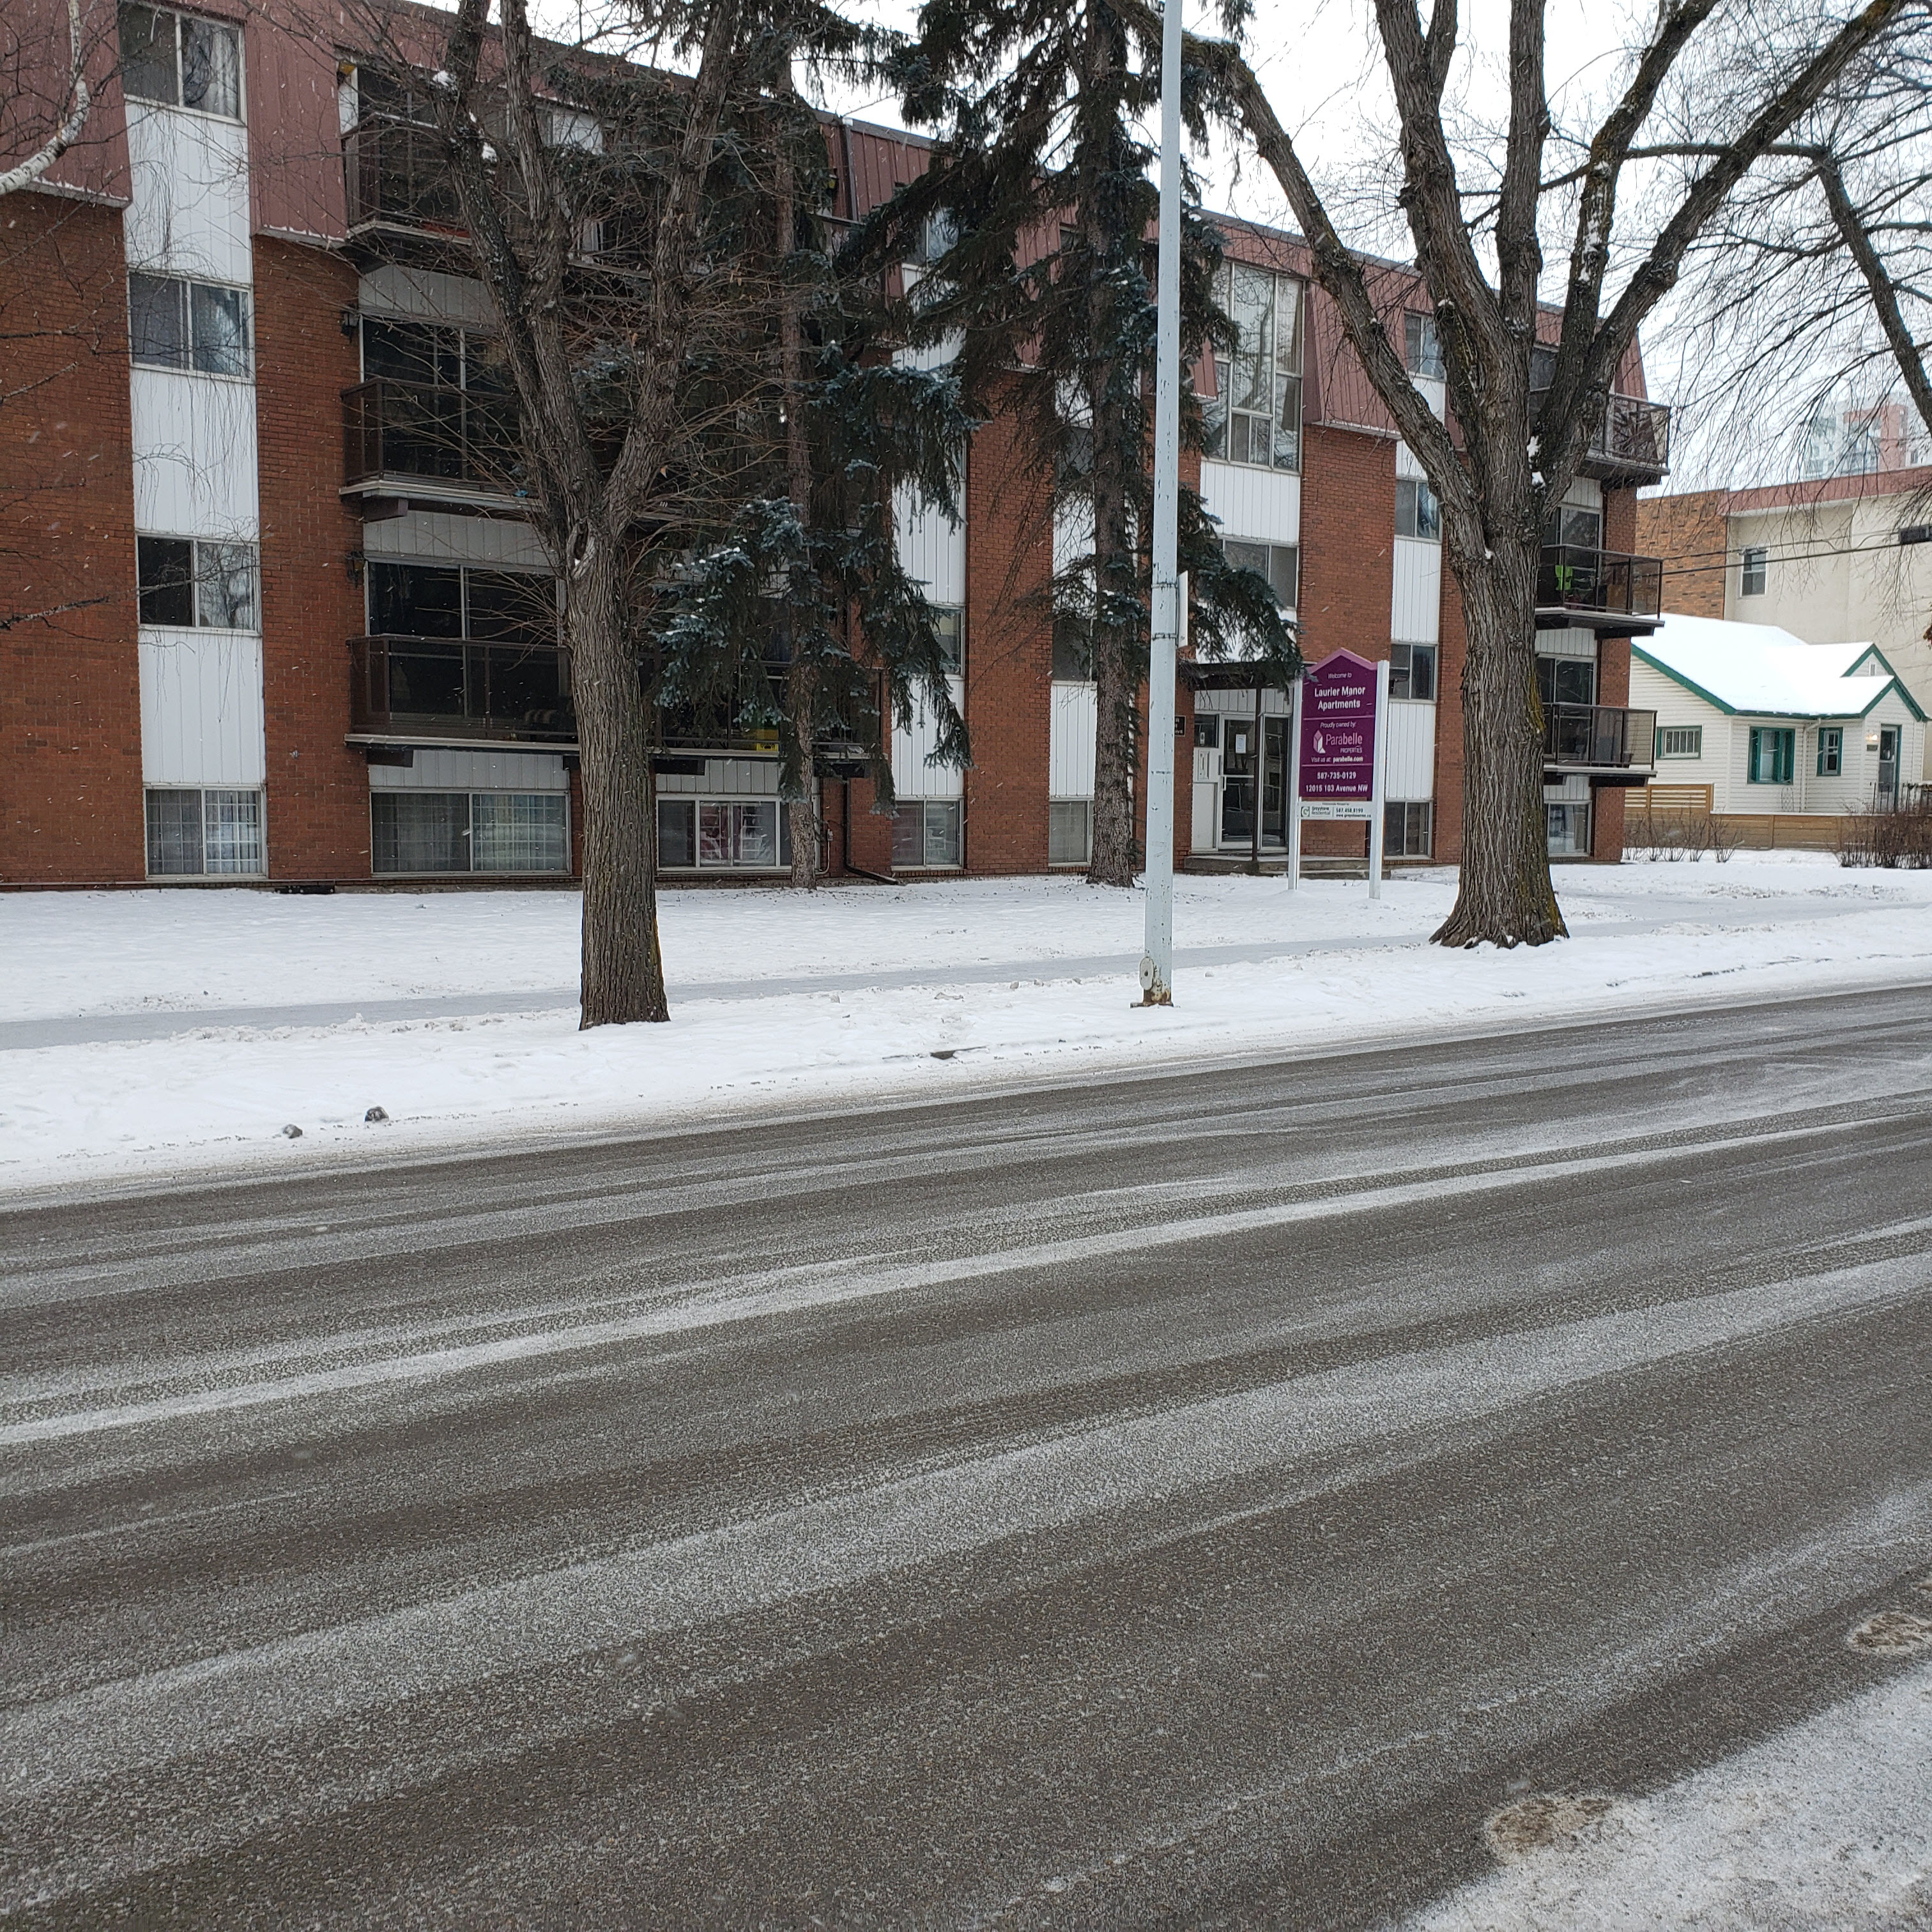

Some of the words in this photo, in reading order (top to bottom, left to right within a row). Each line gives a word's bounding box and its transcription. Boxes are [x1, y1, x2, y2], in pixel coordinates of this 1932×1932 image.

[1314, 686, 1340, 697] Laurier
[1341, 686, 1366, 696] Manor
[1318, 699, 1361, 712] Apartments
[1326, 732, 1363, 745] Parabelle
[1335, 784, 1356, 792] Avenue
[1358, 784, 1368, 792] NW
